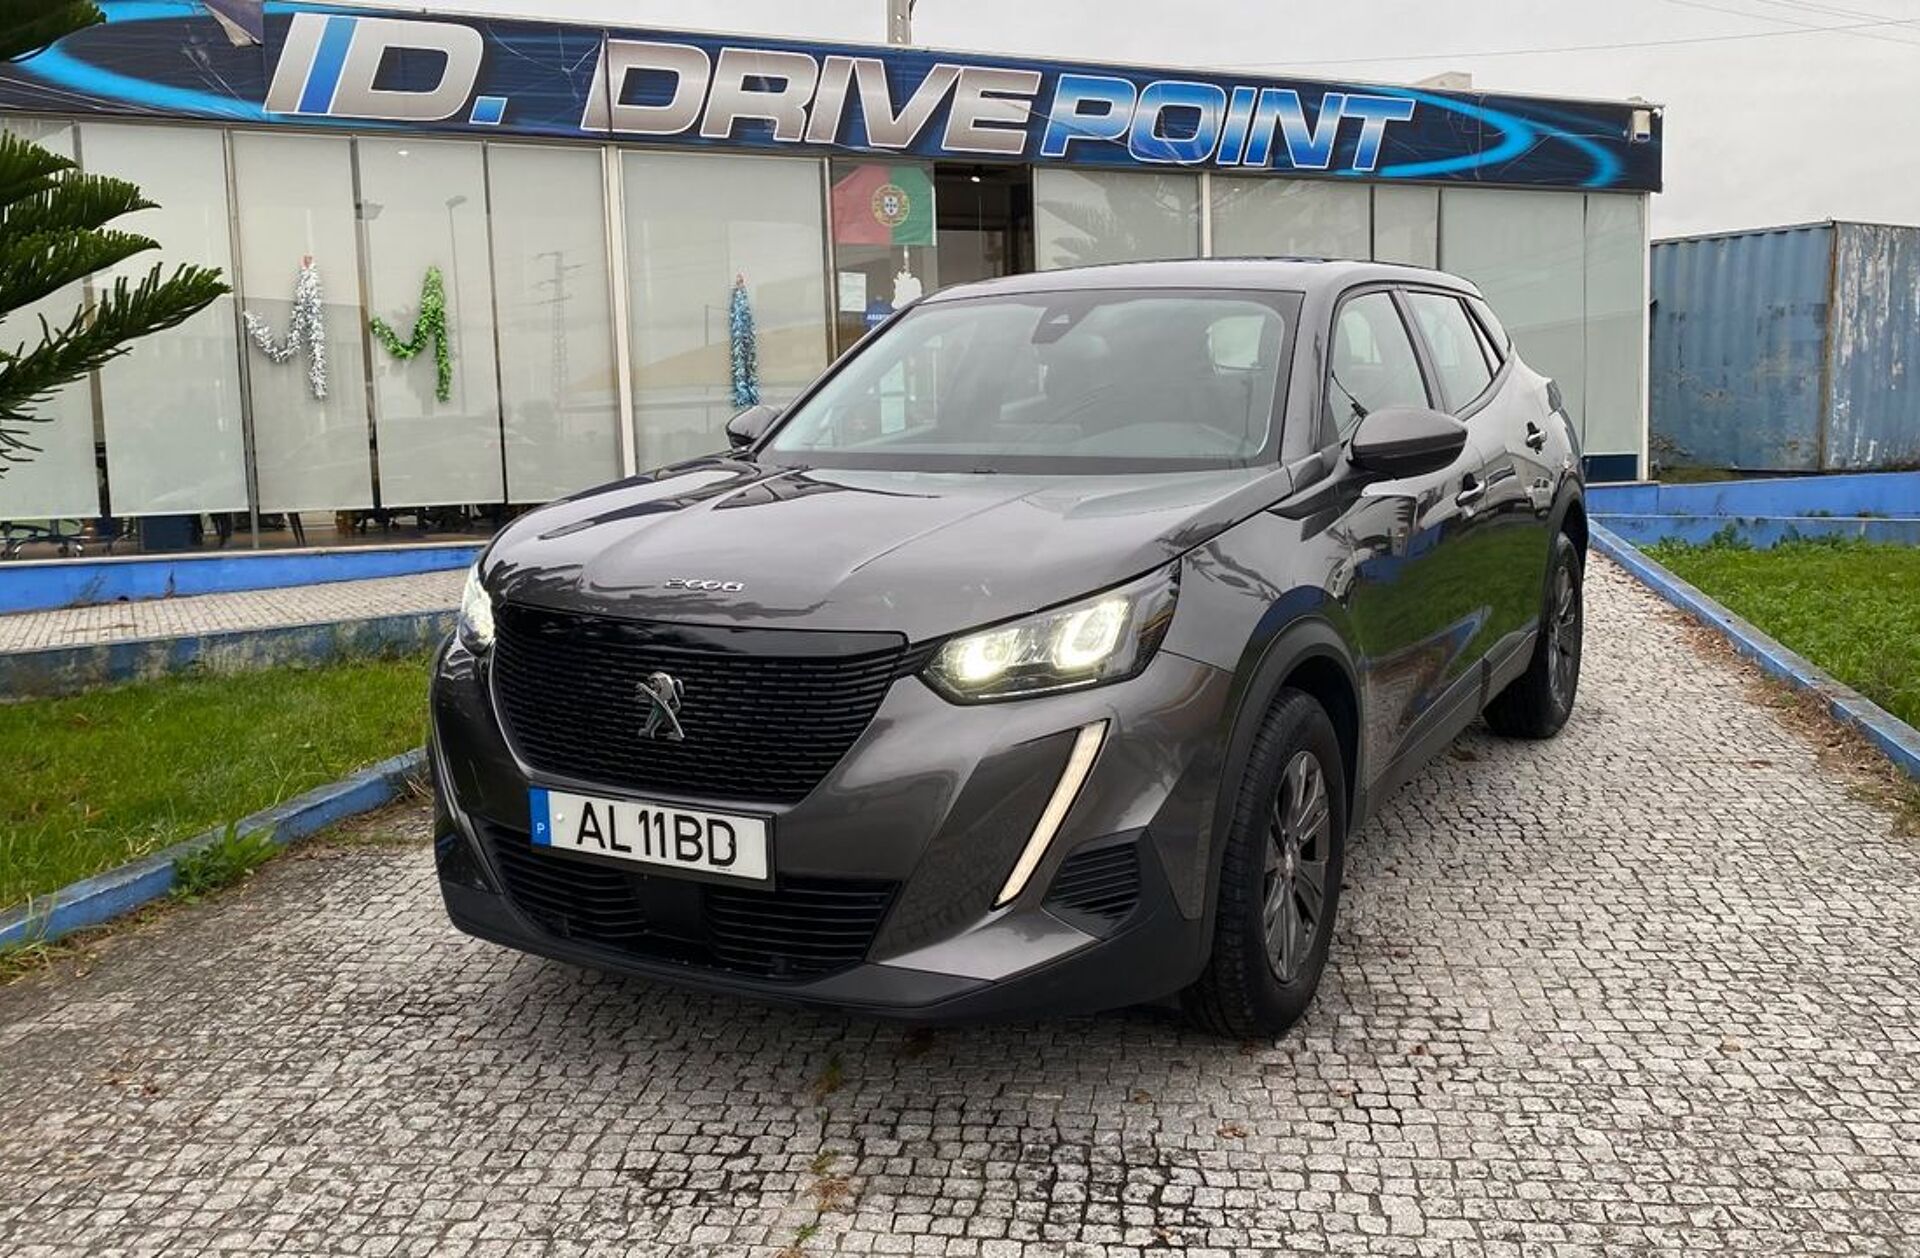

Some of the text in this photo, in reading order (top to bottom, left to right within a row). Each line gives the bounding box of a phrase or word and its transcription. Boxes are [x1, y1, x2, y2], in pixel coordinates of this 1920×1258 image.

[580, 37, 1042, 155] DRIVE
[1040, 73, 1416, 171] POINT
[536, 822, 546, 834] P
